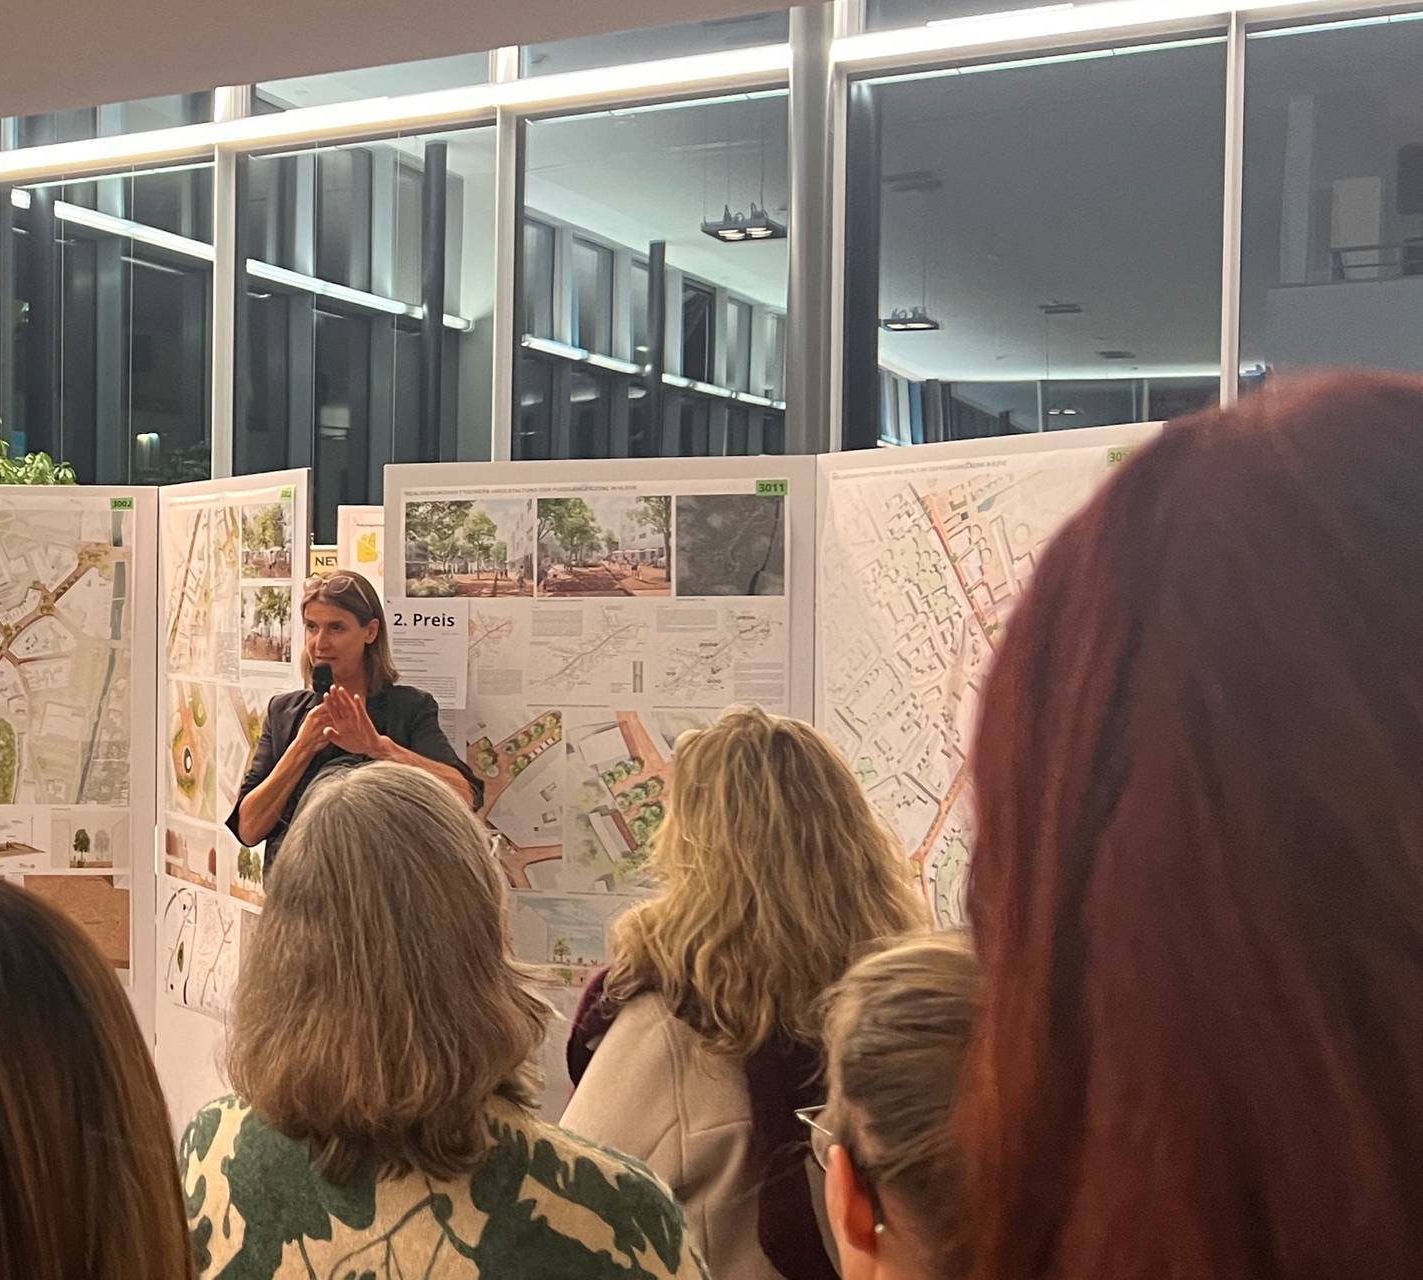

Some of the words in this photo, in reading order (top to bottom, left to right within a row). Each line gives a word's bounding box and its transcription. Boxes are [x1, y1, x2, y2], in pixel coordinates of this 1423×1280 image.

[758, 483, 785, 493] 3011
[315, 556, 338, 566] NE
[393, 613, 408, 627] 2.
[413, 612, 456, 628] Preis
